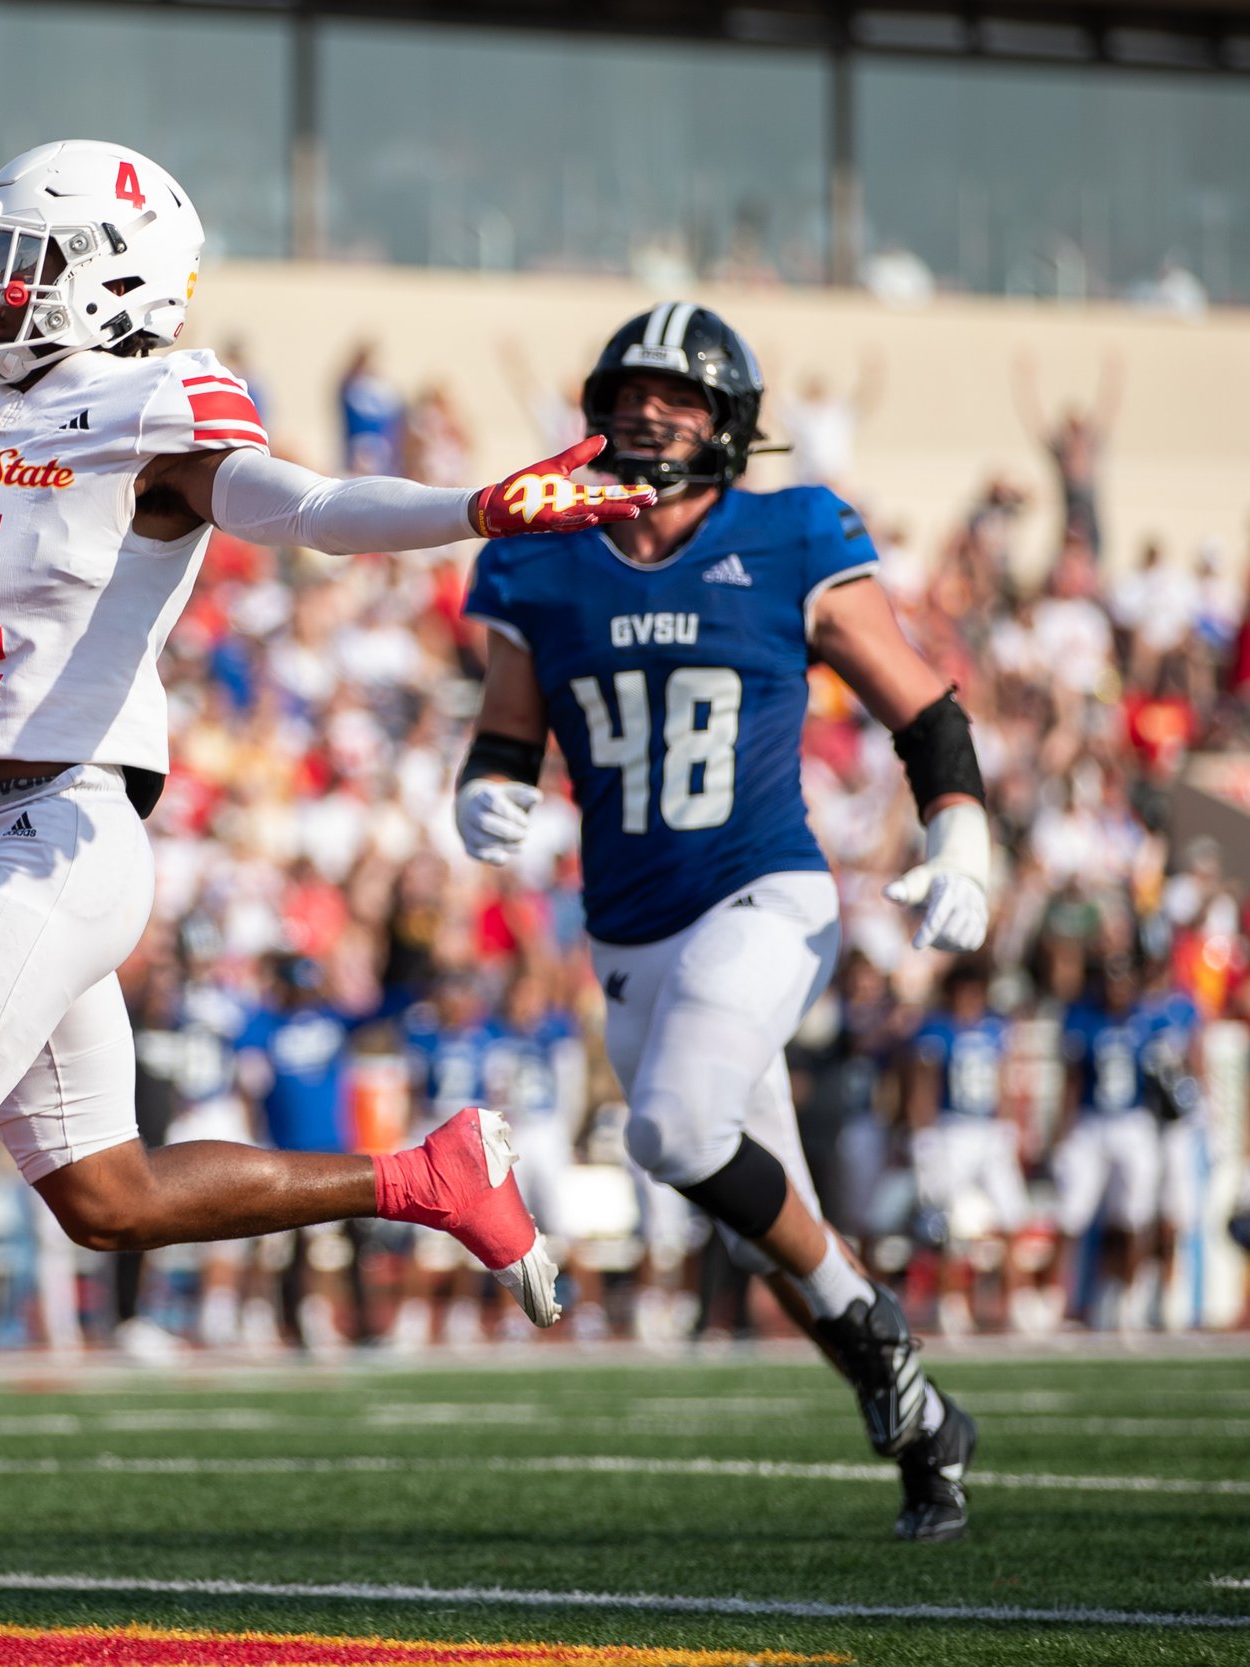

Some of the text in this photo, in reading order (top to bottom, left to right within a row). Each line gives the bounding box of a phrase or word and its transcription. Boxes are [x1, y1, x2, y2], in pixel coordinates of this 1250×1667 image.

[115, 161, 146, 210] 4
[611, 613, 699, 647] GVSU
[571, 667, 741, 834] 48
